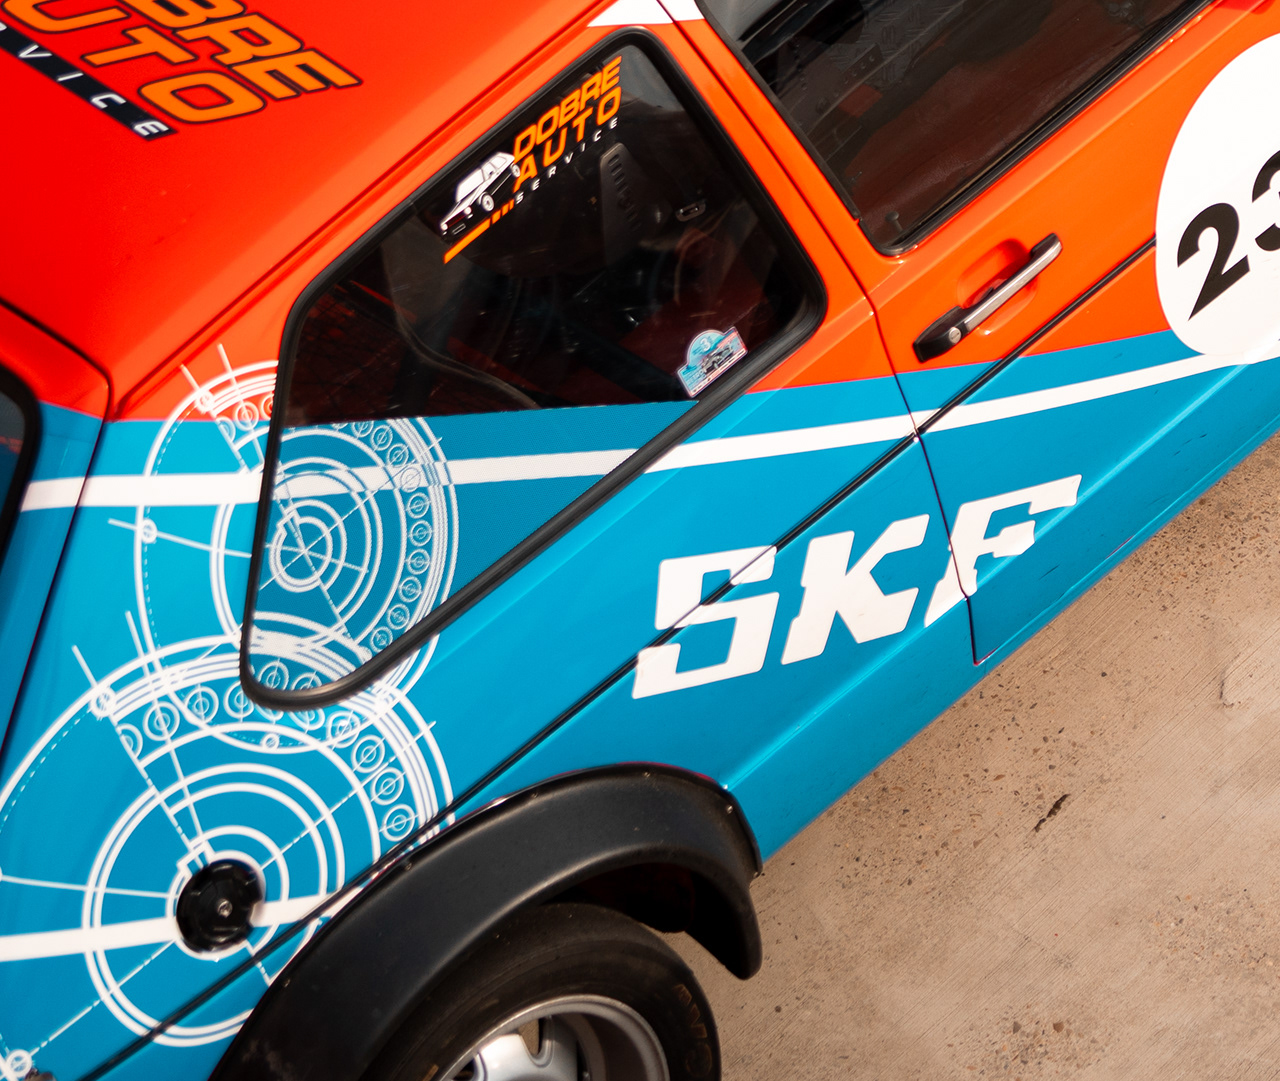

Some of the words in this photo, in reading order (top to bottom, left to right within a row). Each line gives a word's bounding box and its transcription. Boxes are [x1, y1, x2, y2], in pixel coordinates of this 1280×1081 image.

[512, 86, 622, 193] AUTO
[513, 55, 623, 164] DOBRE
[514, 117, 619, 205] SERVICE
[632, 474, 1083, 700] SKF
